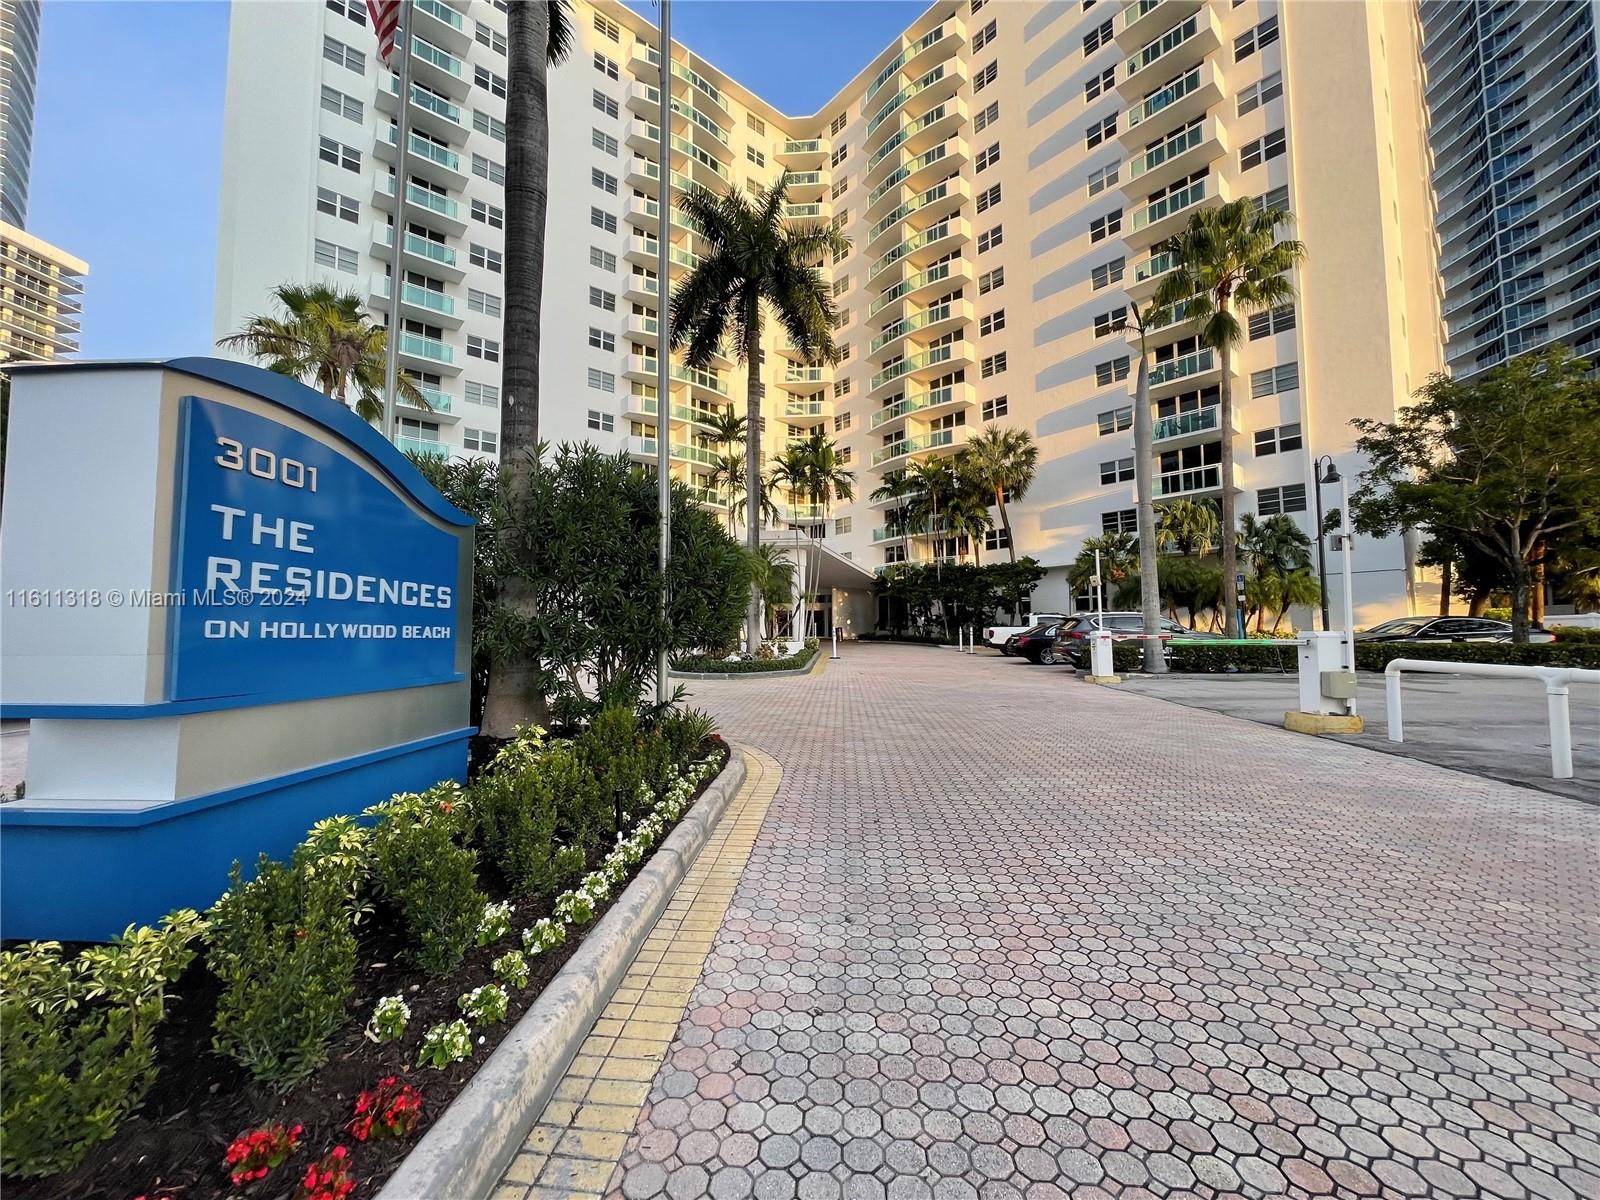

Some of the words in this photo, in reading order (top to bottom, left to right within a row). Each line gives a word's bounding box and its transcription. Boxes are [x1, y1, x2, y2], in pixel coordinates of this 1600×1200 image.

[215, 436, 317, 493] 3001
[210, 503, 315, 554] THE
[207, 556, 452, 609] RESIDENCES
[204, 619, 250, 639] ON
[260, 621, 398, 640] HOLLYWOOD
[402, 624, 451, 640] BEACH
